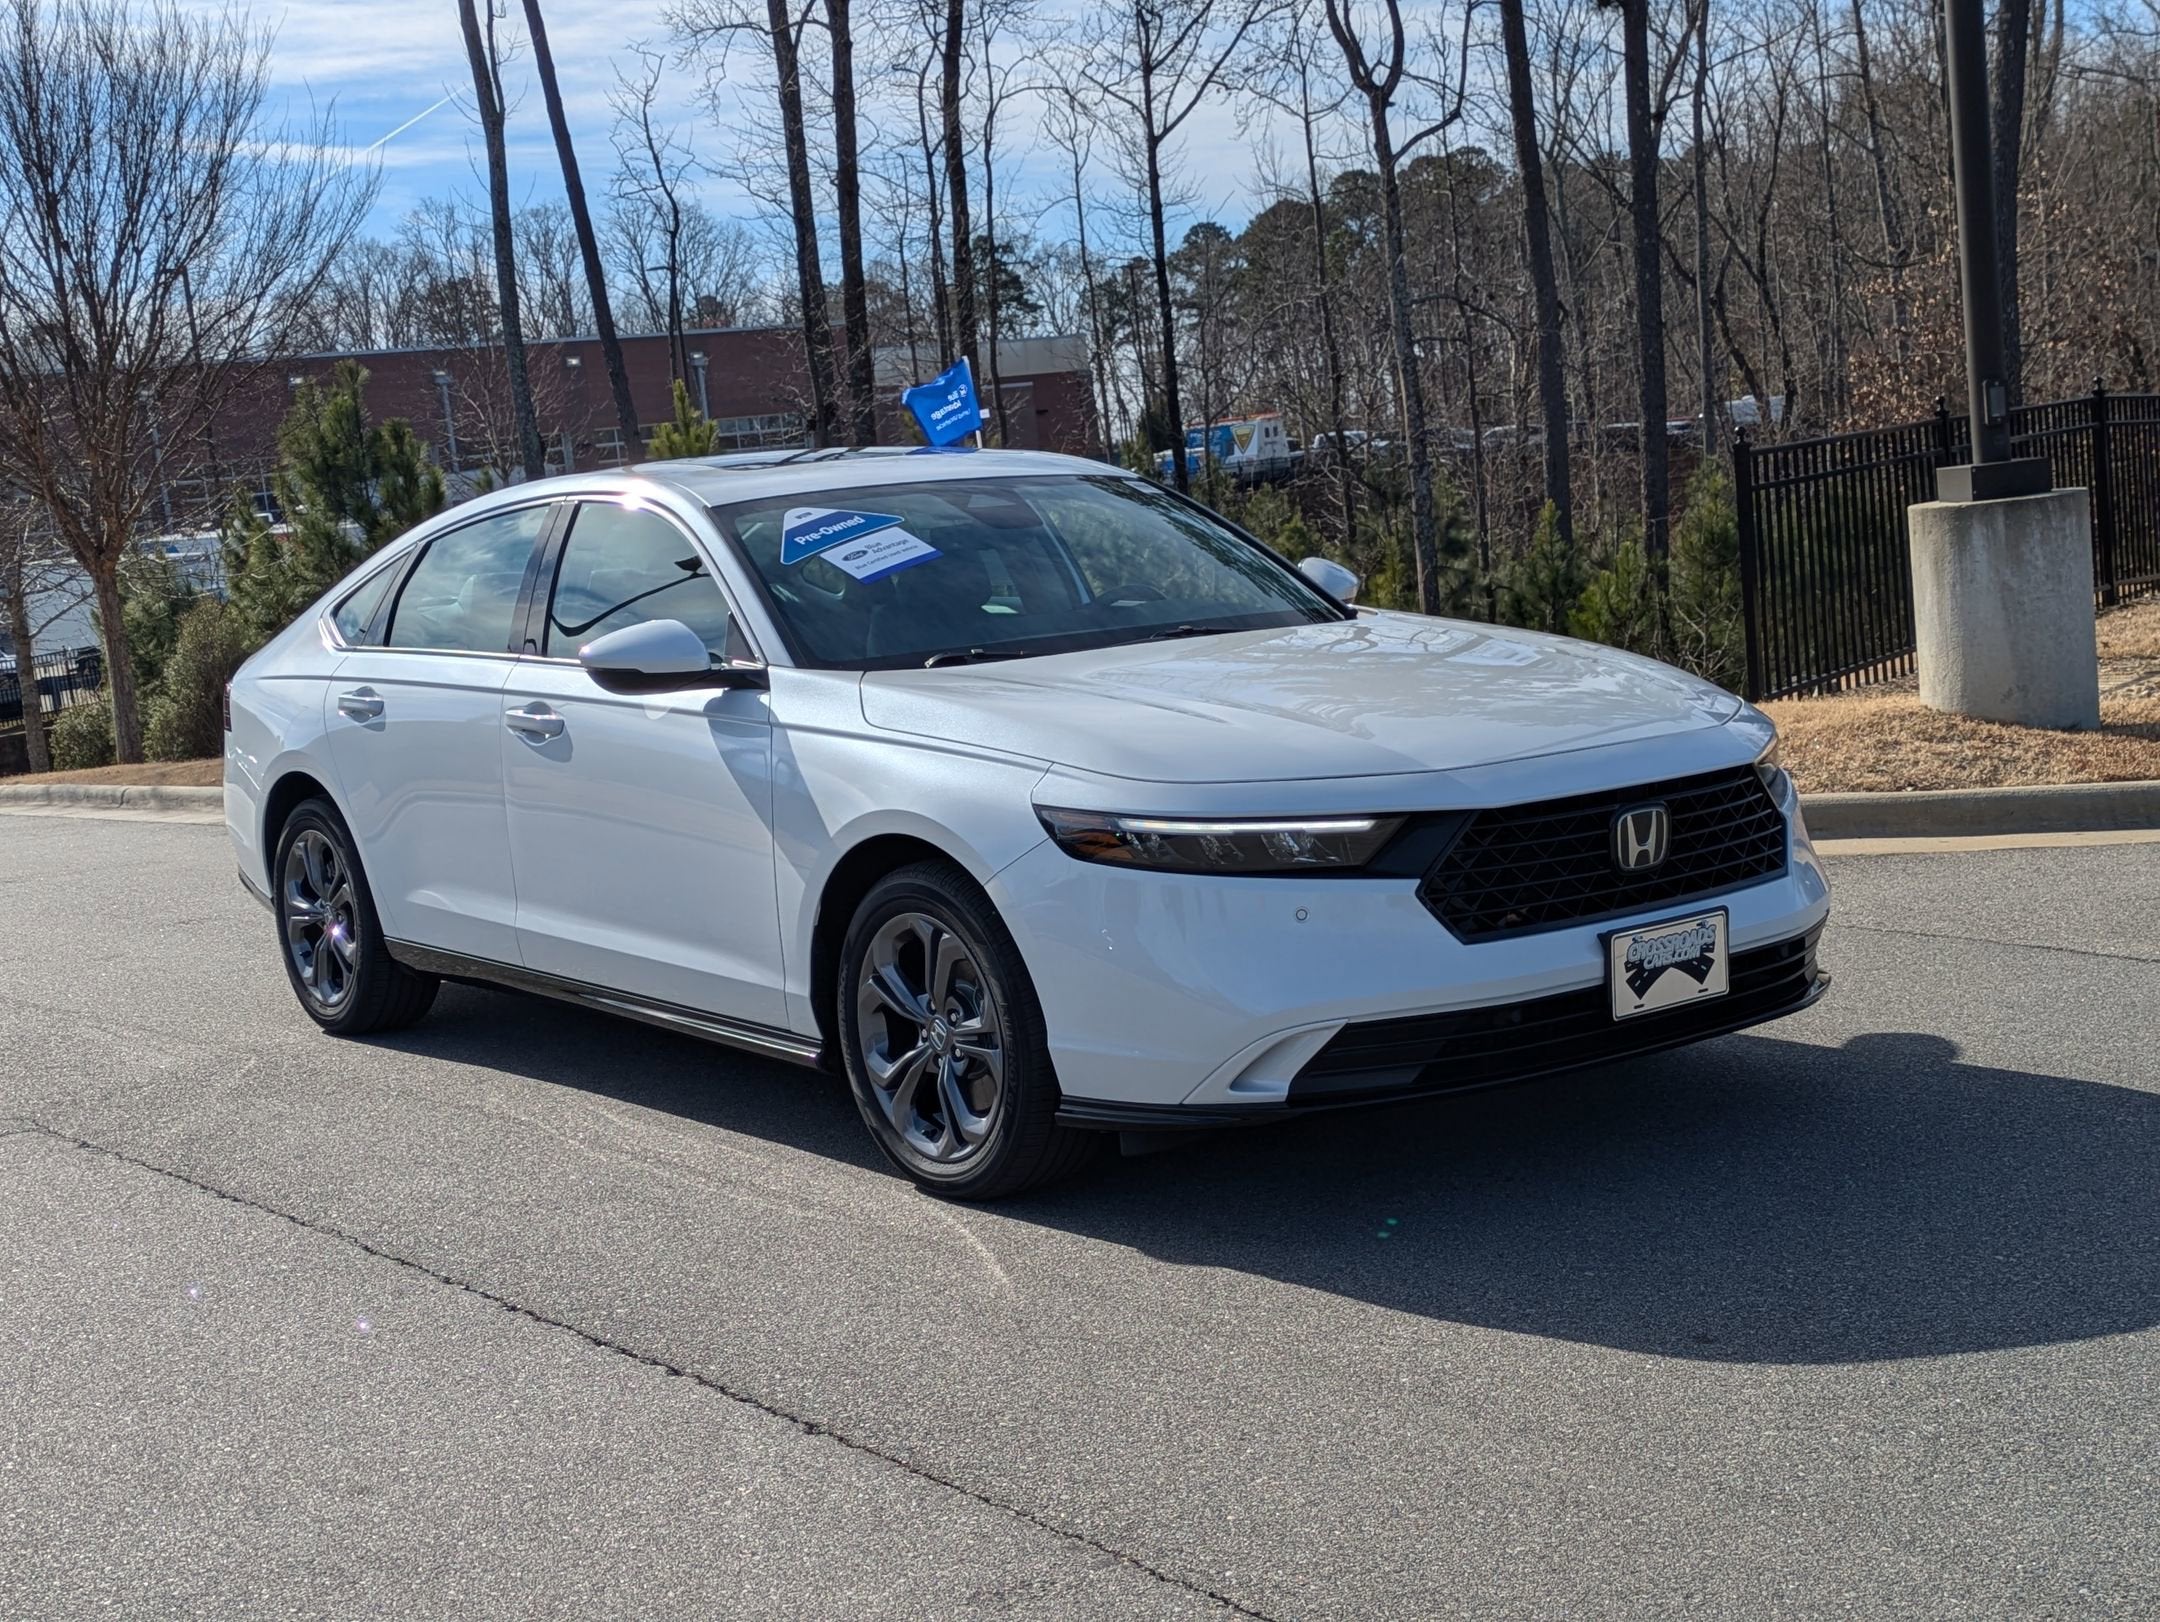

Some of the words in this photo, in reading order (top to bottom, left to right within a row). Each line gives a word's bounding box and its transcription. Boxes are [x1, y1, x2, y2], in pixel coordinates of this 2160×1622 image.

[793, 514, 866, 545] Pre-Owned
[1626, 924, 1717, 963] CROSSROADS
[1643, 945, 1702, 970] CARS.COM
